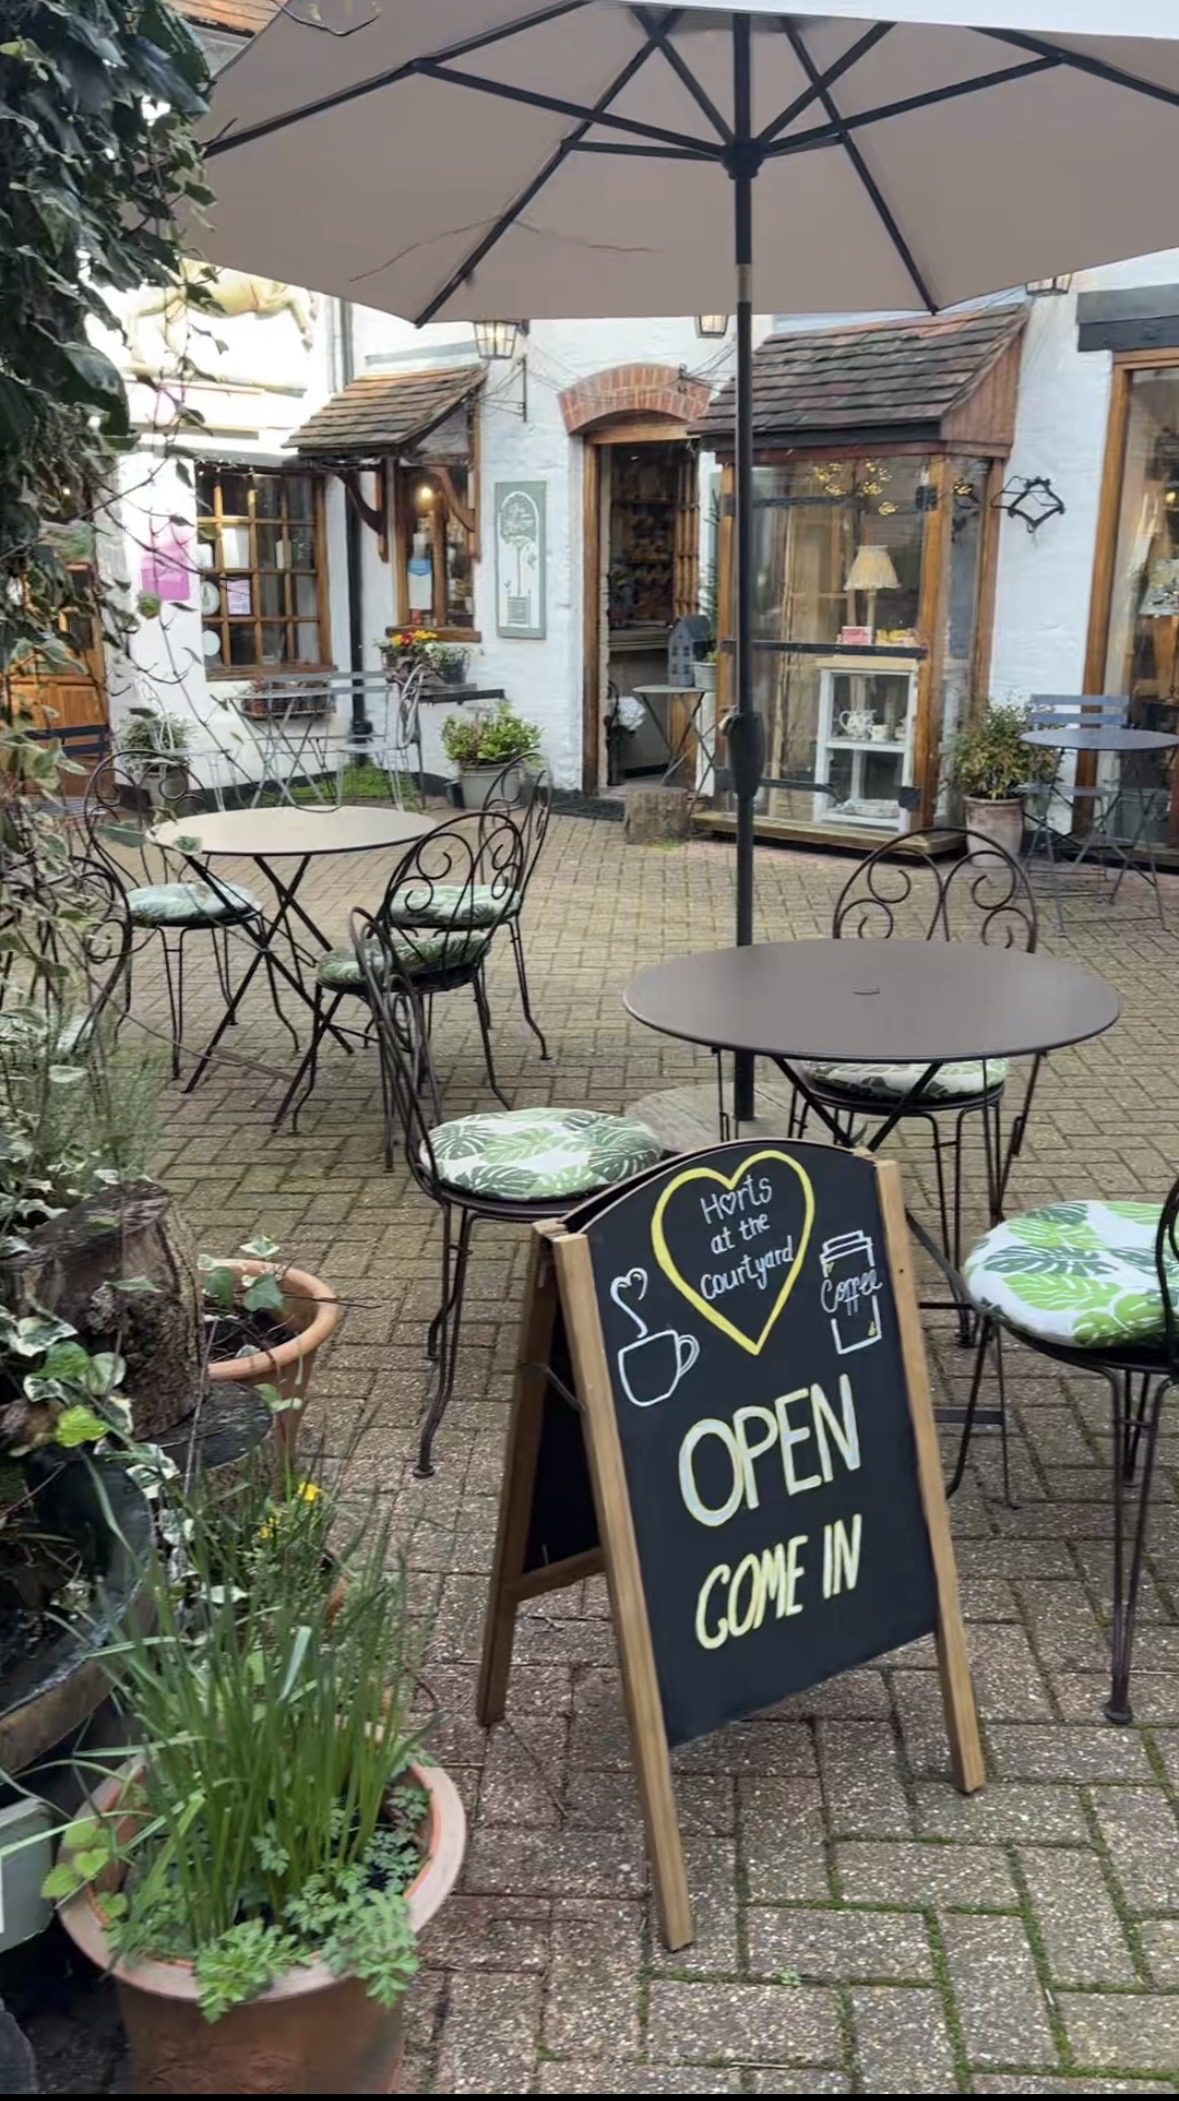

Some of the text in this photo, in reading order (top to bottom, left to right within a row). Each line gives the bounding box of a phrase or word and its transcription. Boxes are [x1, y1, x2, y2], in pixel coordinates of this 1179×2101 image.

[711, 1214, 771, 1254] at the
[821, 1269, 883, 1316] Coffee
[678, 1373, 861, 1527] OPEN
[695, 1513, 862, 1649] COME IN
